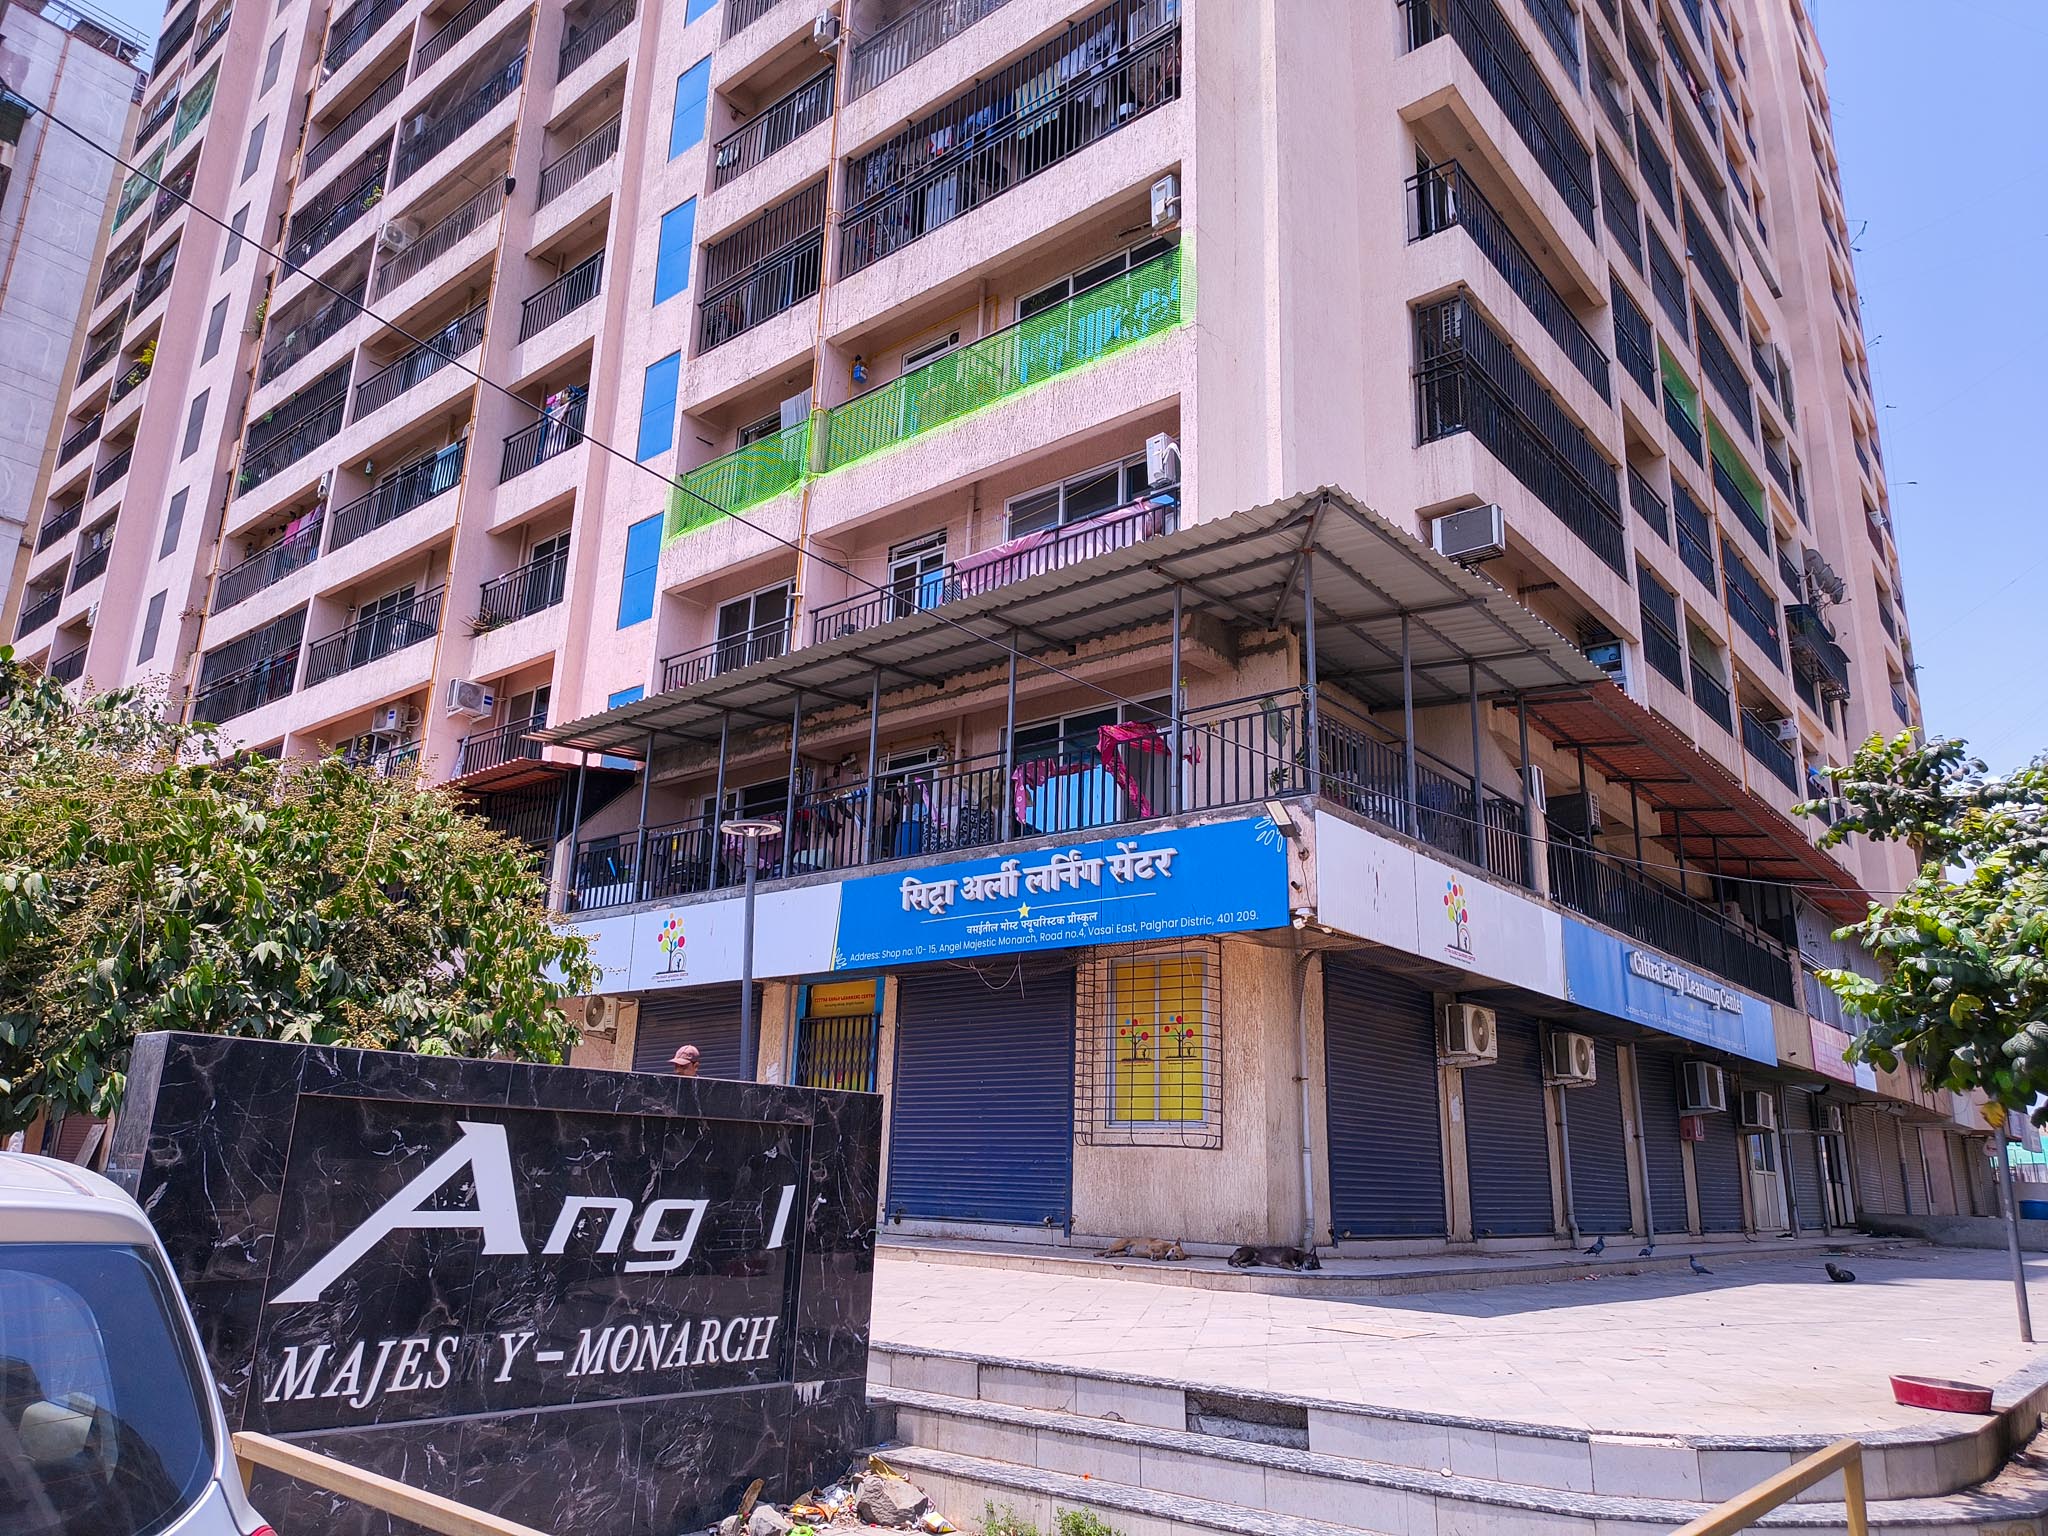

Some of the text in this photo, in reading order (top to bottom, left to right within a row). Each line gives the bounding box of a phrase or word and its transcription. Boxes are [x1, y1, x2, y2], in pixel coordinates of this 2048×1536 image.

[960, 858, 1022, 901] अर्ली
[1022, 850, 1104, 894] लर्निंग
[1105, 841, 1178, 883] सेंटर
[850, 951, 881, 962] Address:
[882, 949, 900, 961] Shop
[939, 942, 962, 955] Angel
[963, 937, 997, 952] Majestic
[999, 933, 1038, 946] Monarch,
[1040, 930, 1063, 942] Road
[1065, 929, 1086, 941] no.4,
[1088, 925, 1114, 936] Vasai
[1116, 922, 1139, 934] East,
[1141, 919, 1178, 934] Palghar
[1180, 914, 1215, 928] Distric,
[1217, 912, 1234, 924] 401
[1237, 910, 1259, 921] 209.
[966, 921, 997, 935] वसईतील
[1001, 919, 1018, 932] मोस्ट
[1068, 911, 1098, 927] प्रीस्कूल
[1661, 962, 1685, 995] Early
[1685, 973, 1721, 1010] Learning
[1720, 988, 1743, 1014] Center
